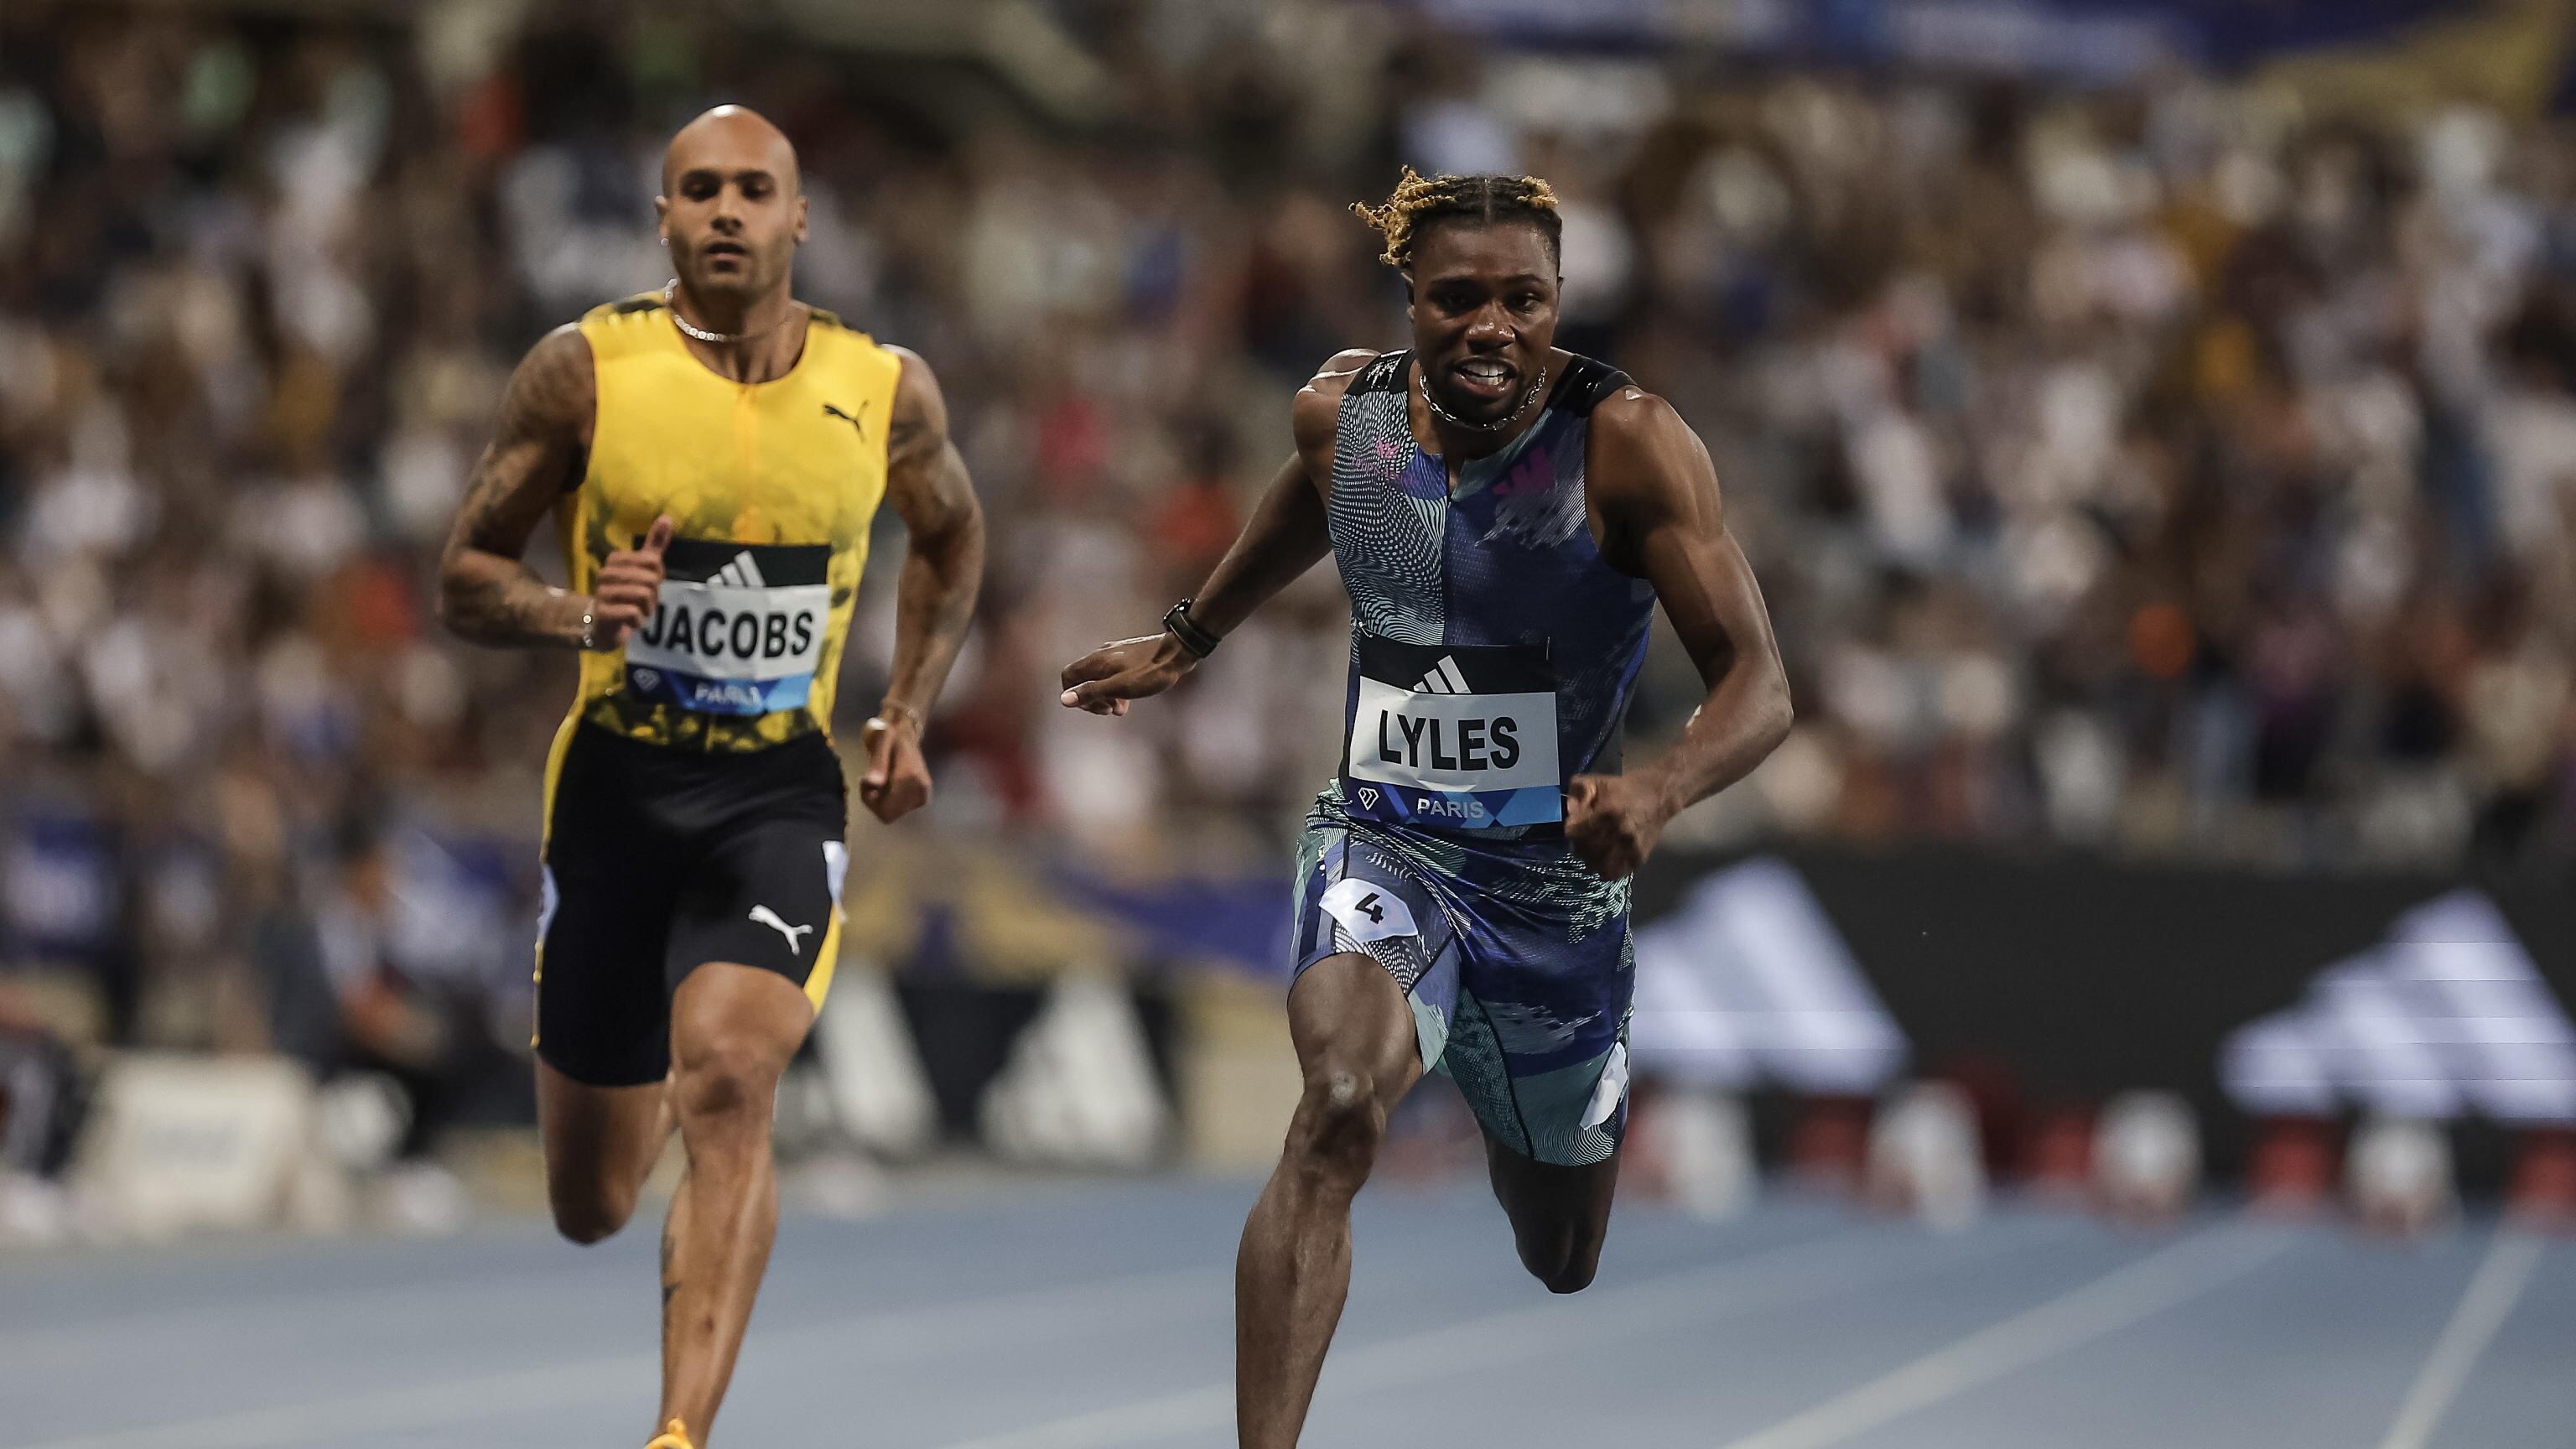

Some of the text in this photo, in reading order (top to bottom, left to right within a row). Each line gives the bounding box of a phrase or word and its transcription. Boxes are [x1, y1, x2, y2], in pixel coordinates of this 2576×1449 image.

[641, 604, 813, 658] JACOBS
[1379, 709, 1520, 771] LYLES
[1416, 797, 1484, 820] PARIS
[1354, 891, 1384, 924] 4
